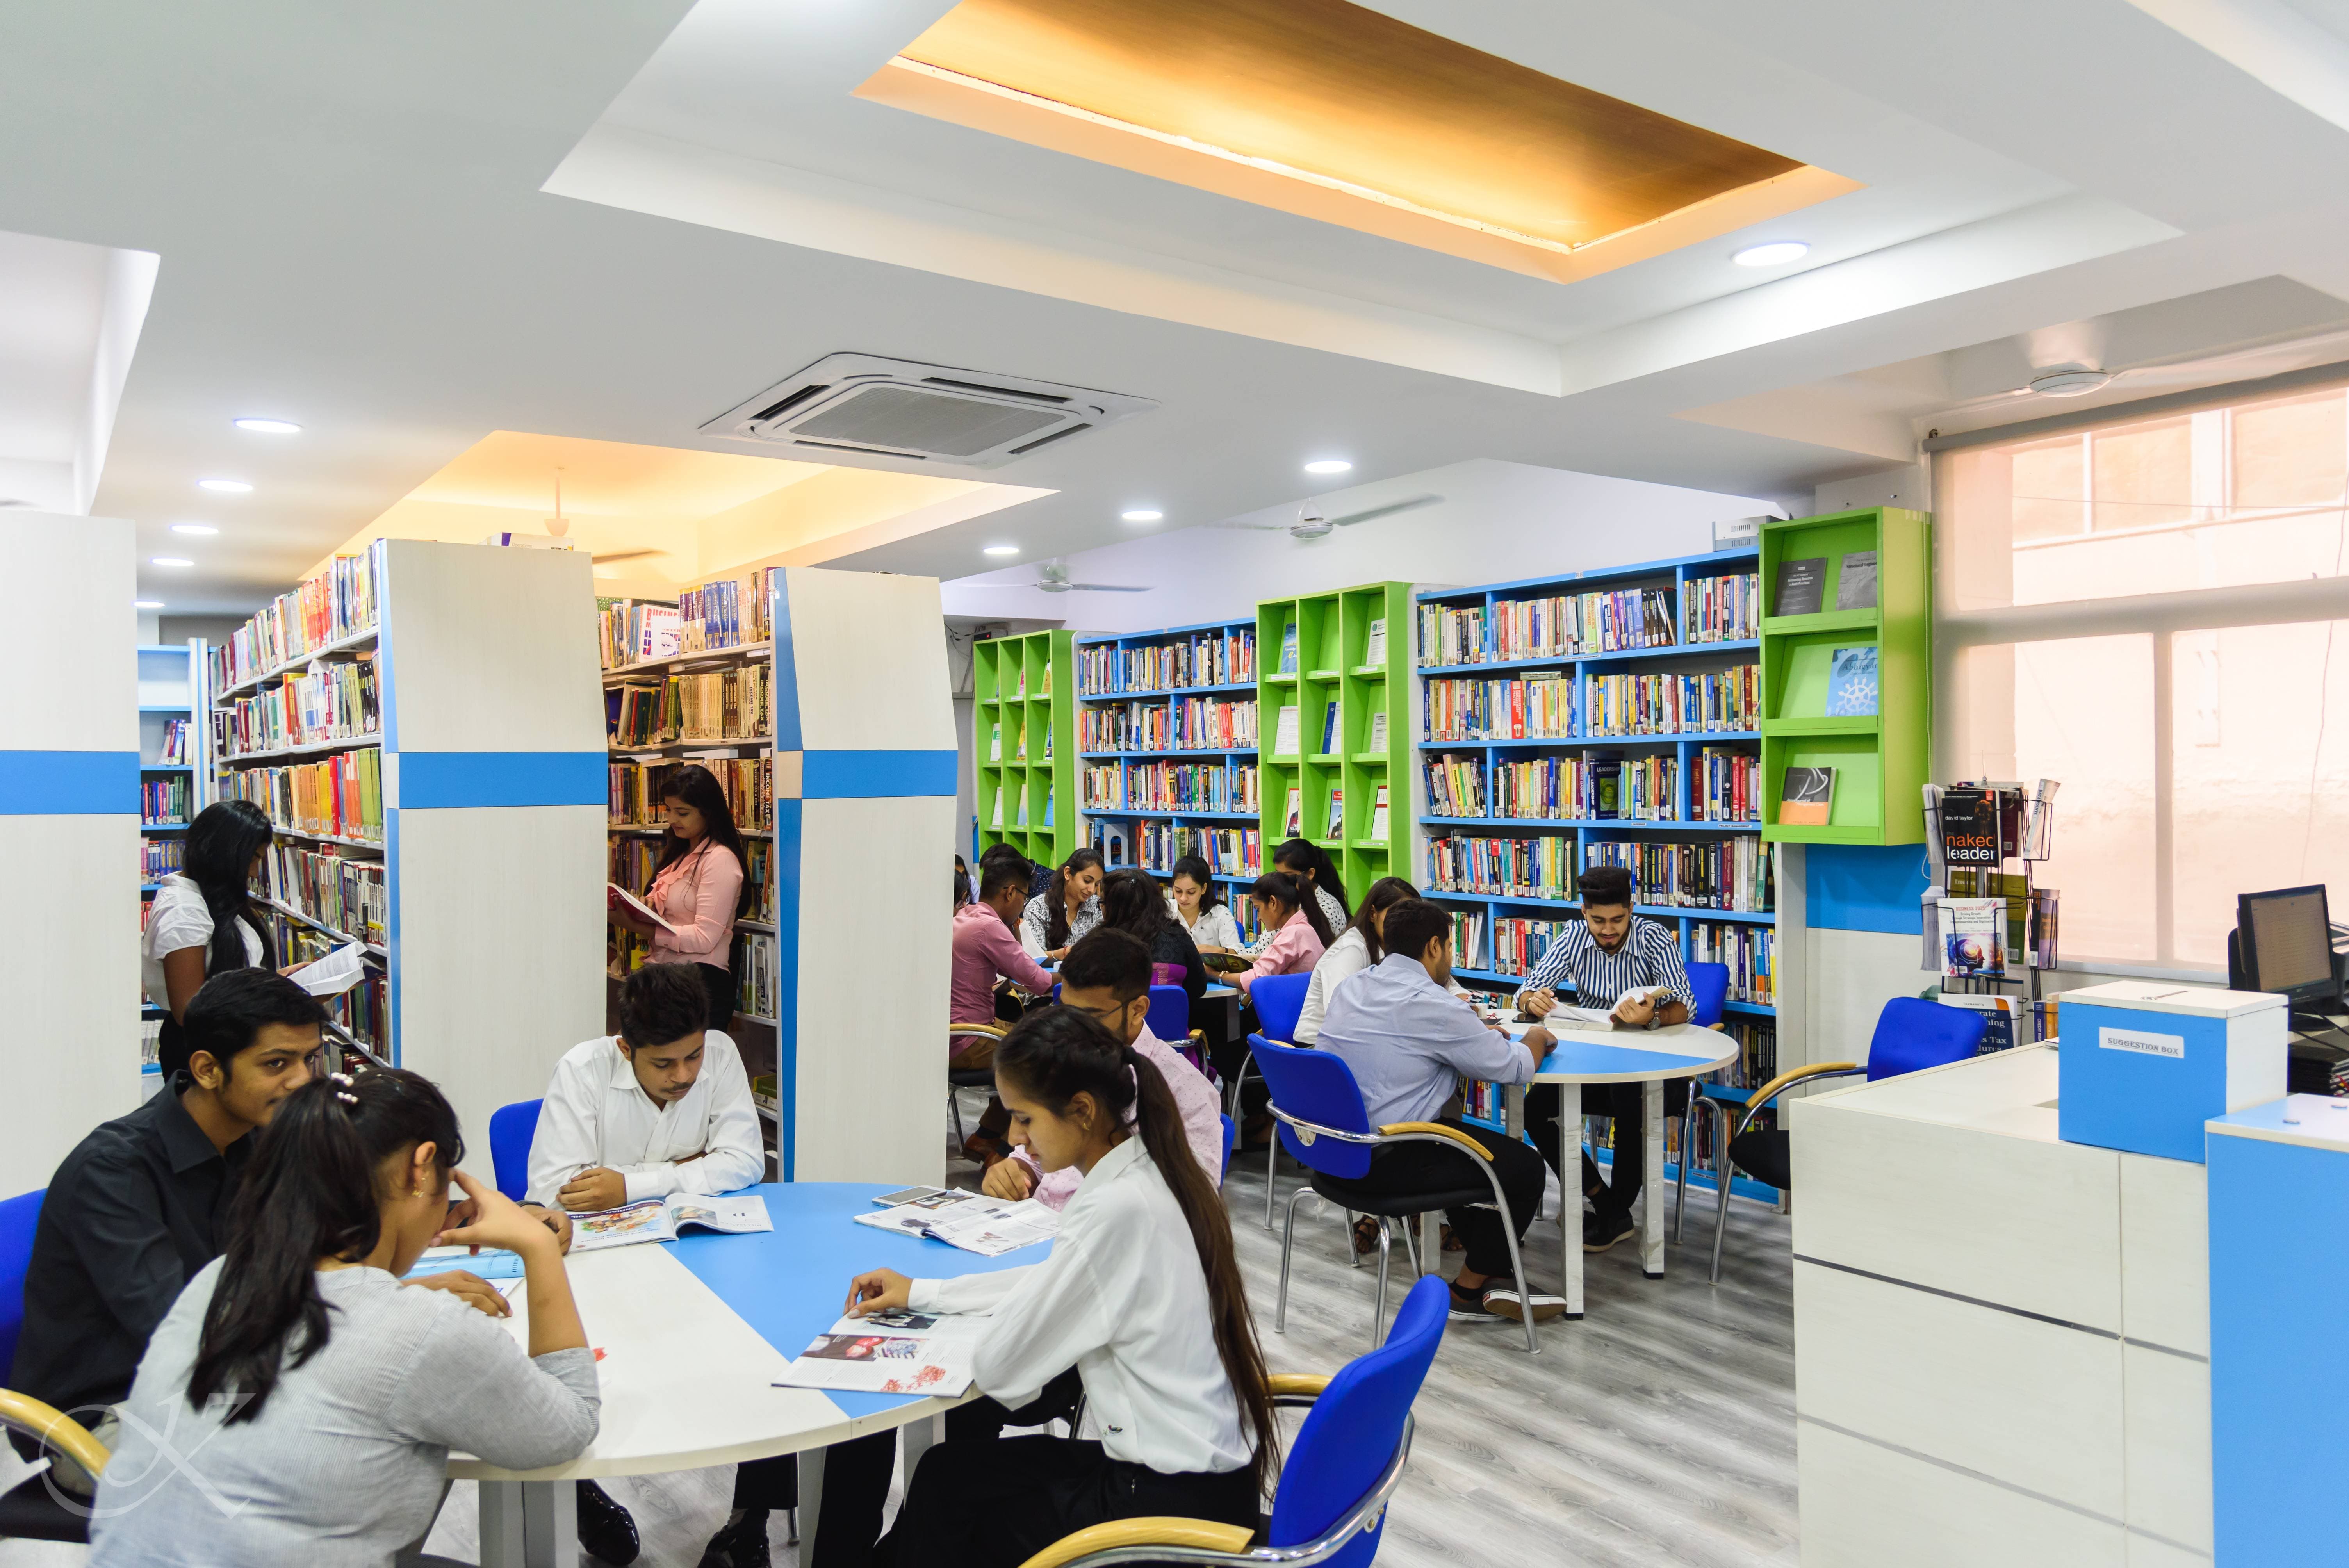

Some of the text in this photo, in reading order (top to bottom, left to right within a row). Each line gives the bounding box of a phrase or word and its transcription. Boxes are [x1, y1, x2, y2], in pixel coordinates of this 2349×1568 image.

[1946, 833, 1996, 846] naked
[1947, 846, 1995, 859] leader
[2107, 1037, 2179, 1055] SUGGESTION BOX
